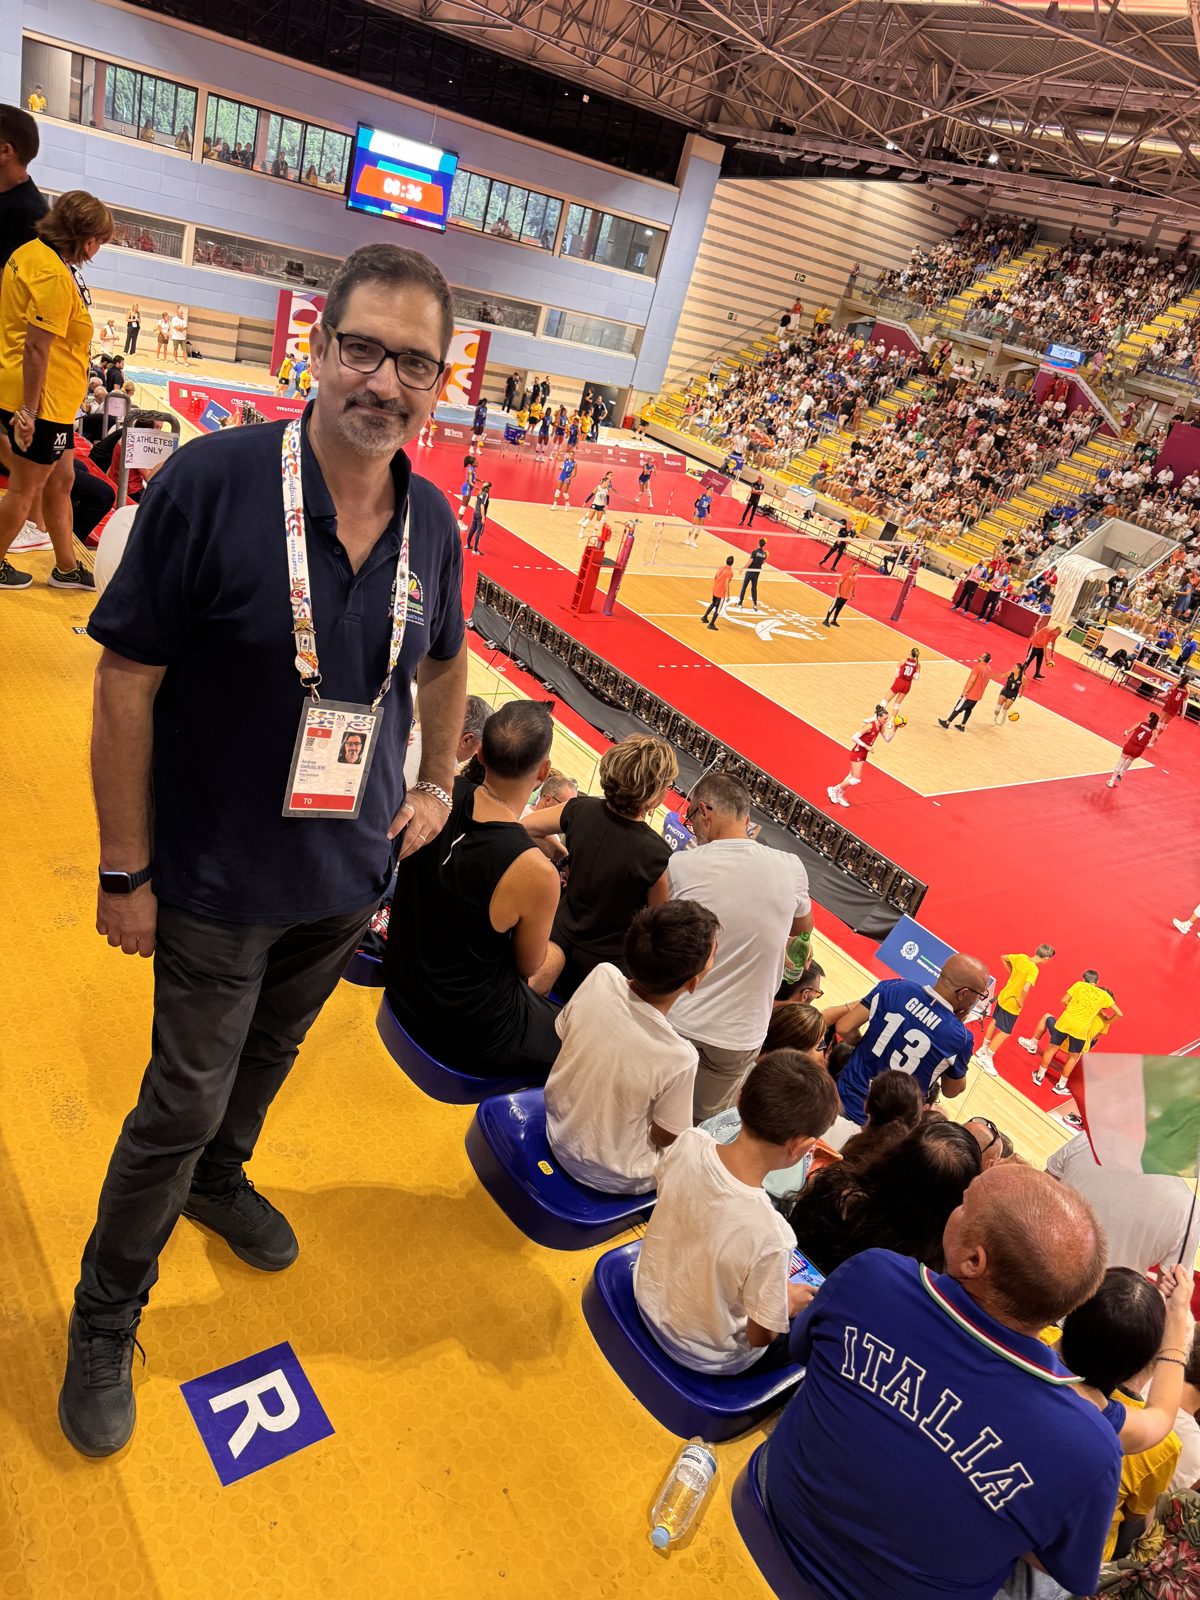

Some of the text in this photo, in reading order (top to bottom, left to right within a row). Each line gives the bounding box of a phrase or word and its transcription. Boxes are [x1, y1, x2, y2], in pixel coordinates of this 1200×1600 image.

[136, 435, 173, 448] ATHLETES
[142, 445, 163, 455] ONLY
[903, 665, 914, 677] 10
[1174, 692, 1182, 701] 8
[1137, 731, 1146, 741] 4
[666, 823, 685, 840] PHOTO
[904, 997, 942, 1031] GIANI
[871, 1012, 932, 1077] 13
[208, 1368, 301, 1460] R
[841, 1325, 1034, 1511] ITALIA
